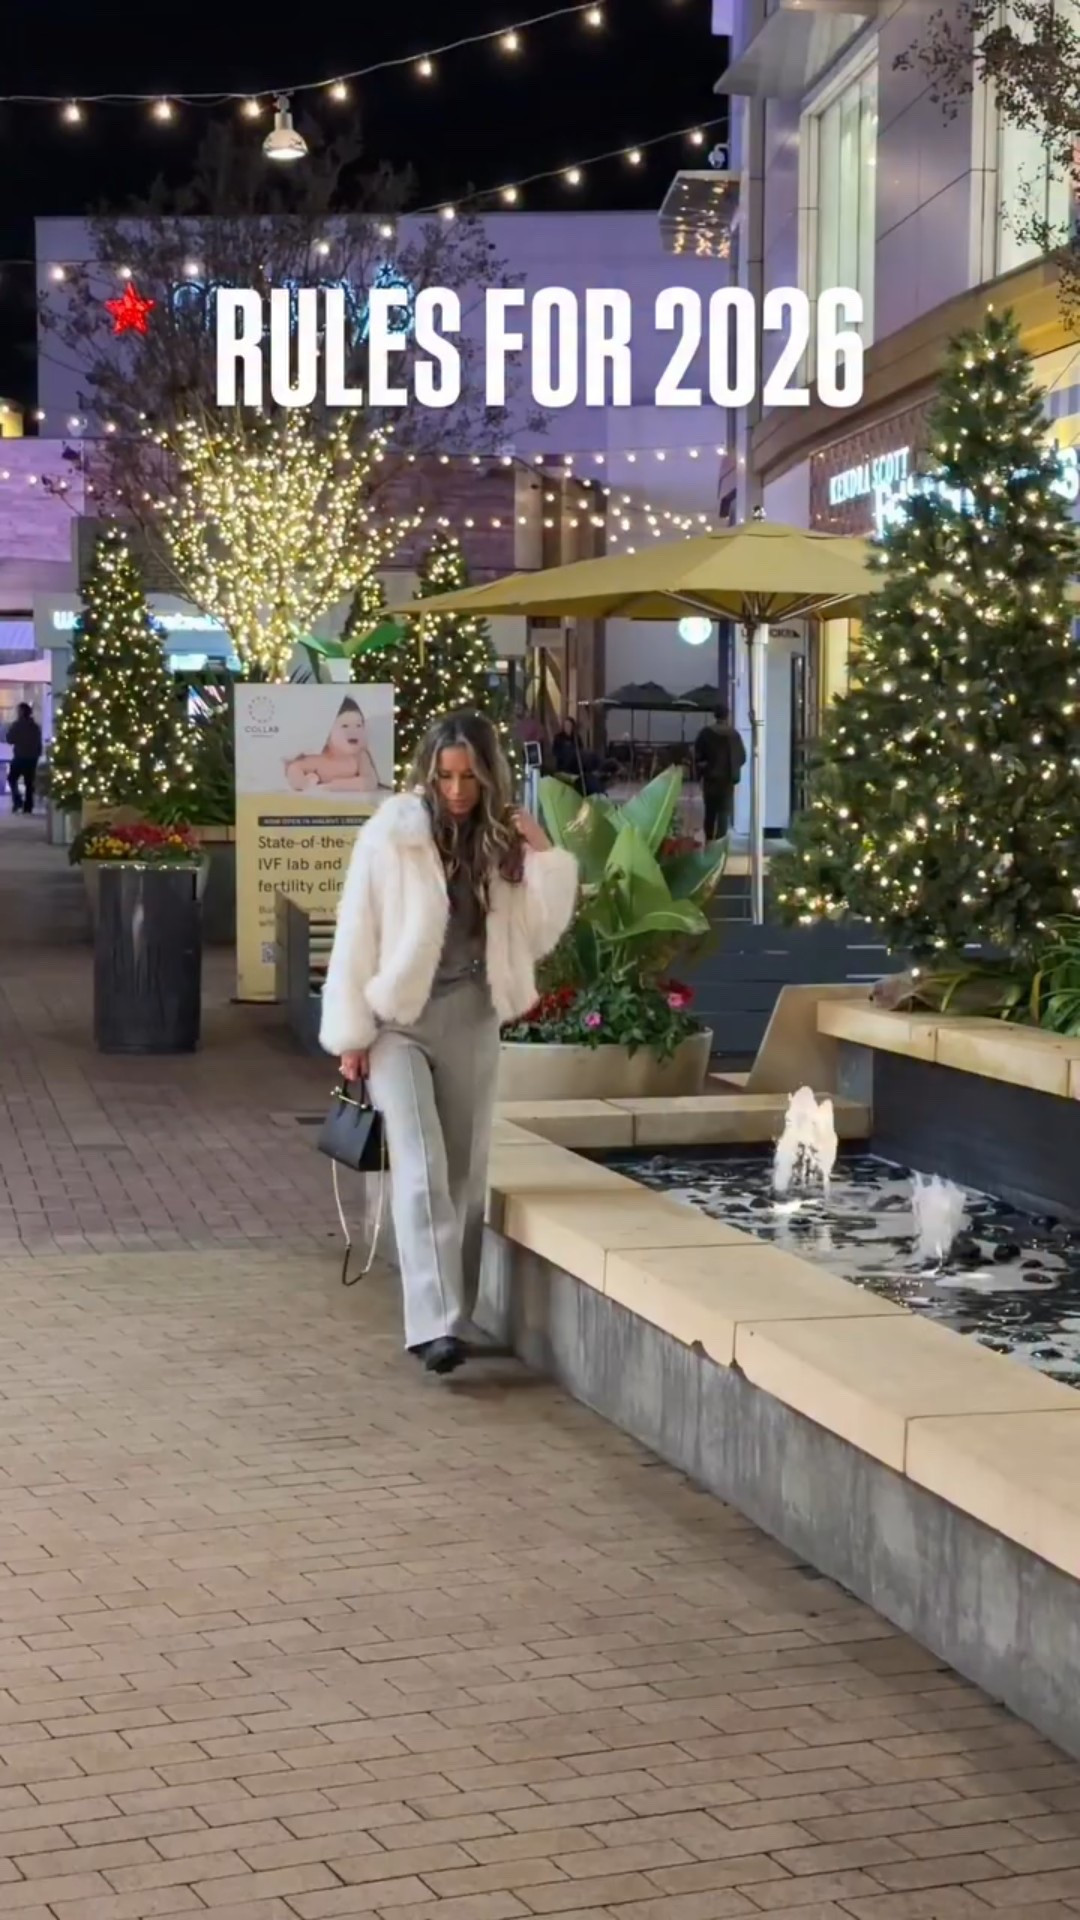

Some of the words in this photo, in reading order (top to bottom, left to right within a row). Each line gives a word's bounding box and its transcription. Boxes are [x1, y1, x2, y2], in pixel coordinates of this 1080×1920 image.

[872, 446, 910, 489] SCOTT
[244, 725, 279, 733] COLLAB
[258, 835, 354, 849] State-of-the-
[258, 857, 282, 870] IVF
[287, 857, 310, 870] lab
[314, 857, 342, 870] and
[258, 879, 314, 895] fertility
[318, 879, 345, 892] clin
